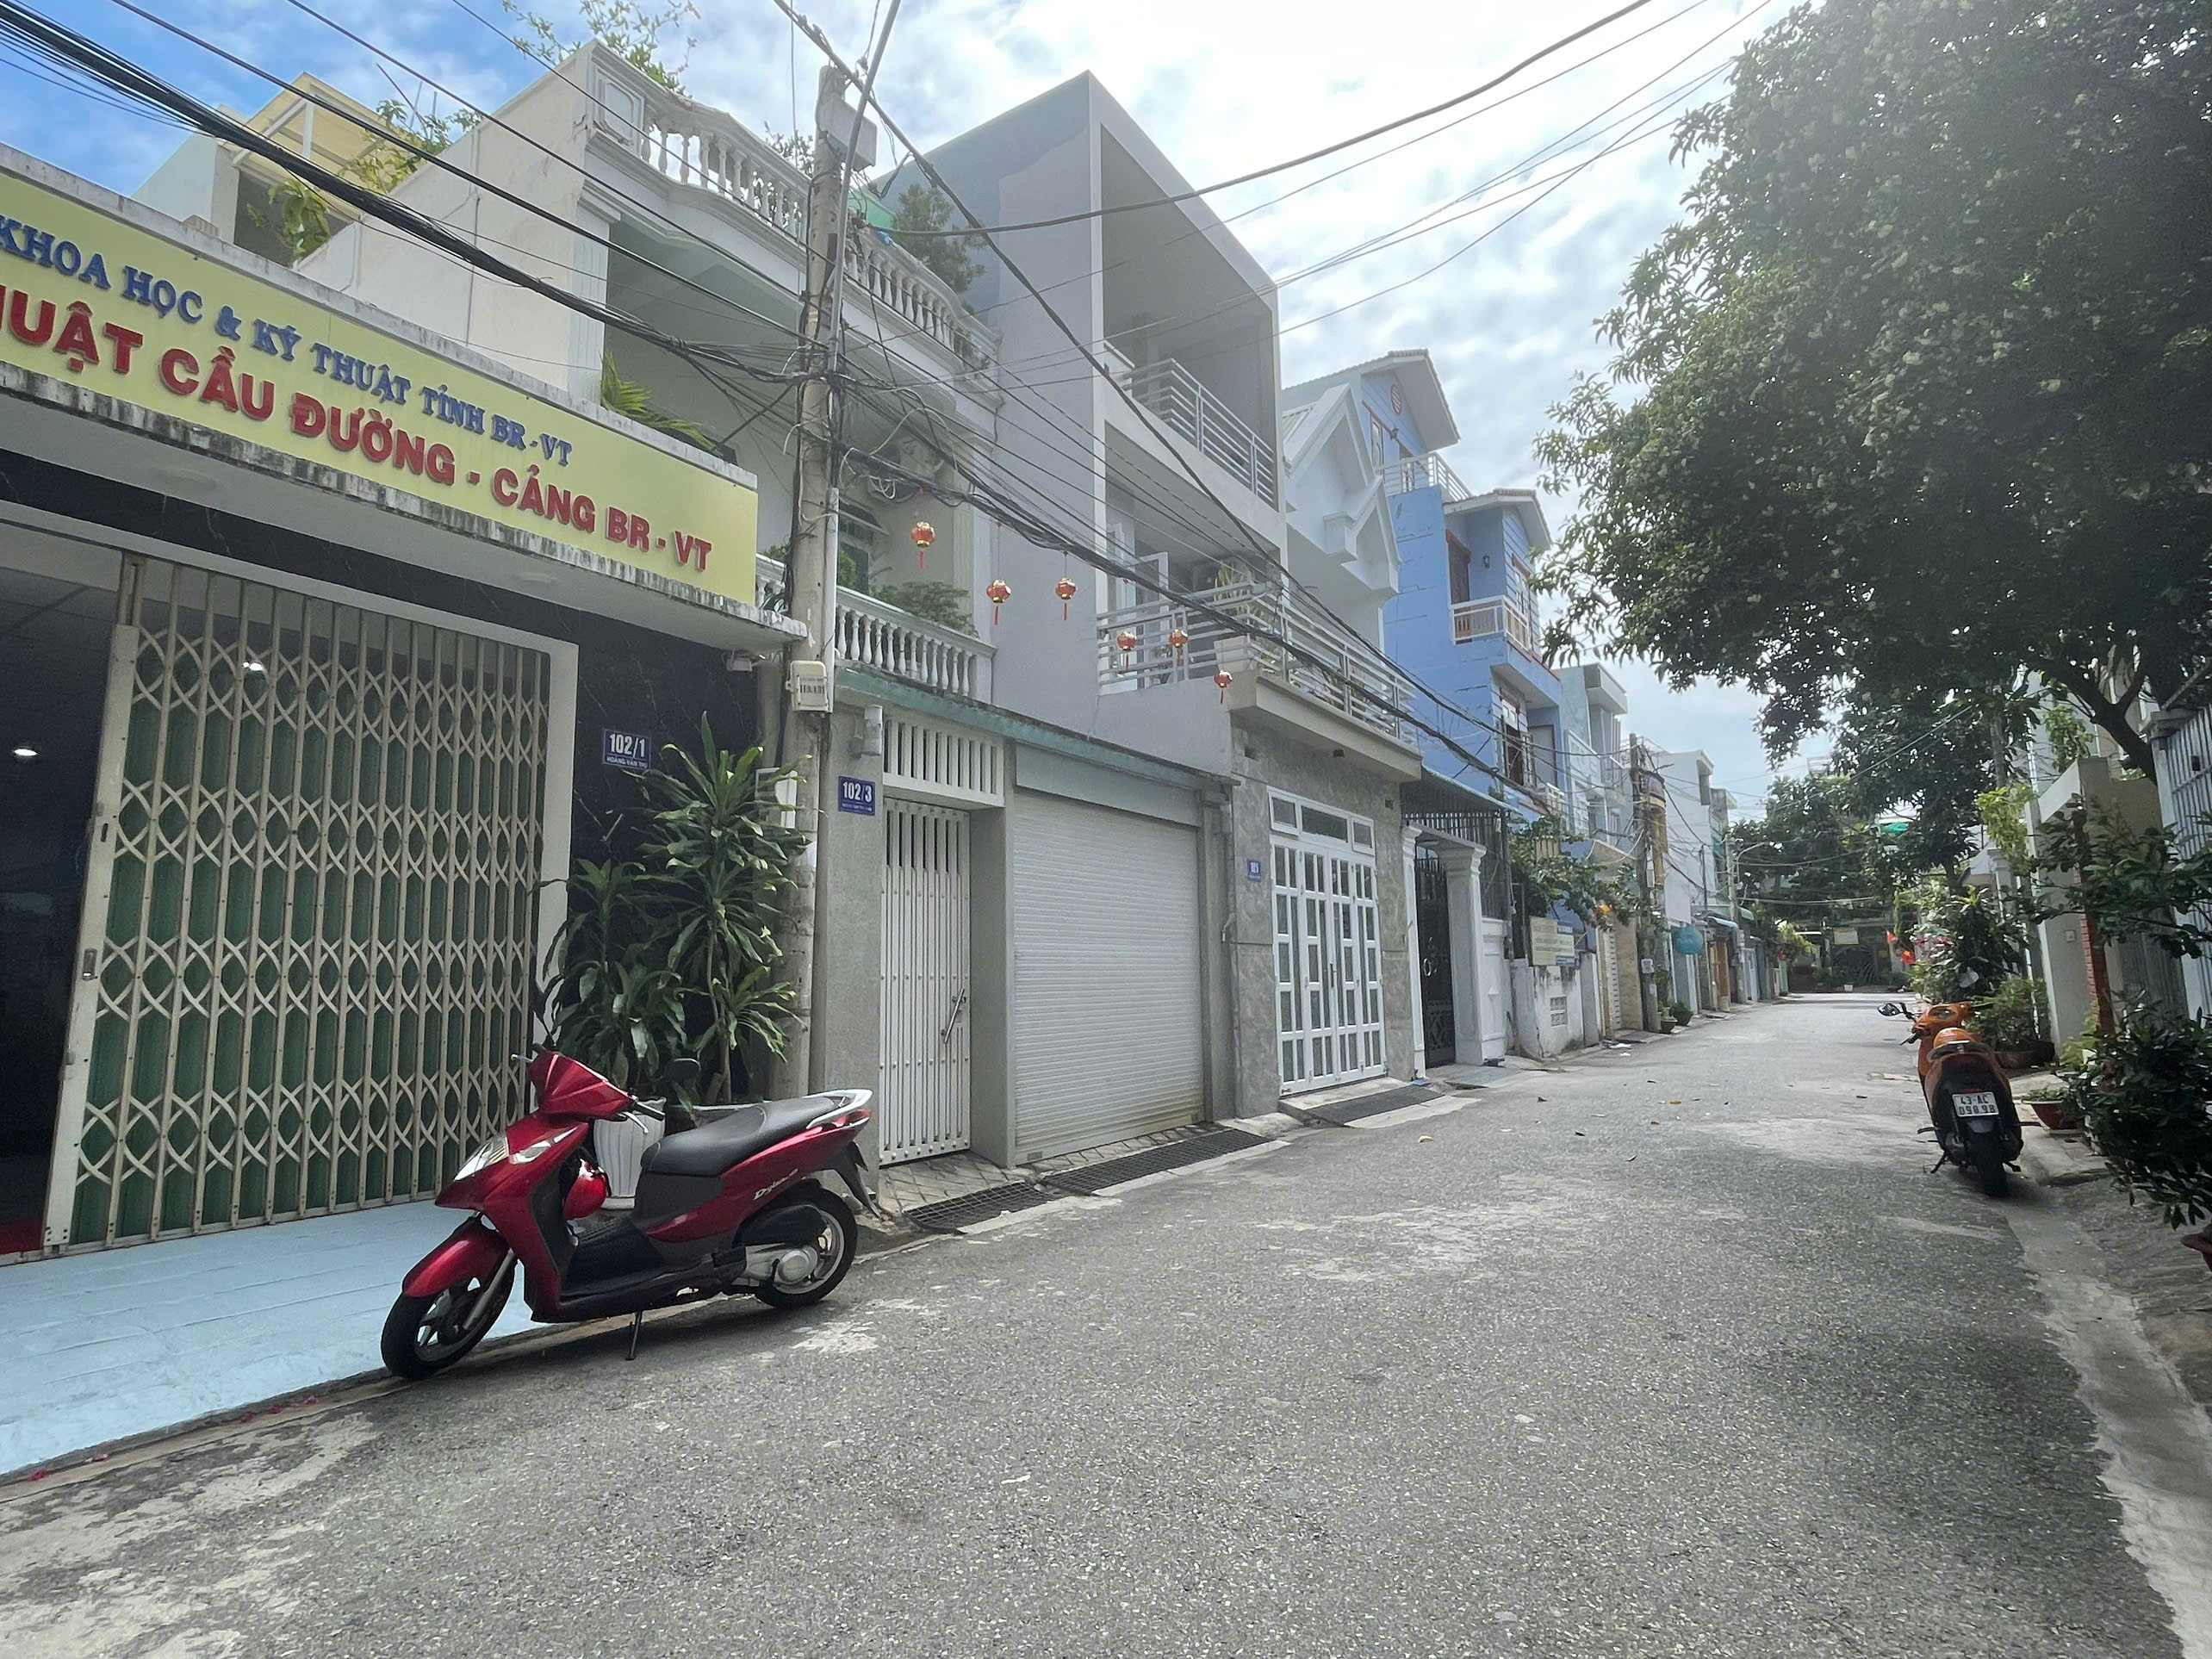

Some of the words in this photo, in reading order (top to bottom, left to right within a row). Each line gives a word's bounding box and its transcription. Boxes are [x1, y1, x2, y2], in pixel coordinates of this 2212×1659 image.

[0, 217, 111, 289] KHOA
[121, 264, 203, 325] HỌC
[215, 305, 242, 342] &
[311, 342, 411, 406] THUẬT
[158, 345, 276, 422] CẦU
[290, 392, 456, 486] ĐƯỜNG
[492, 463, 596, 533] CẢNG
[605, 506, 650, 552] BR
[674, 530, 712, 572] VT
[609, 733, 645, 758] 102/1
[842, 781, 872, 803] 102/3
